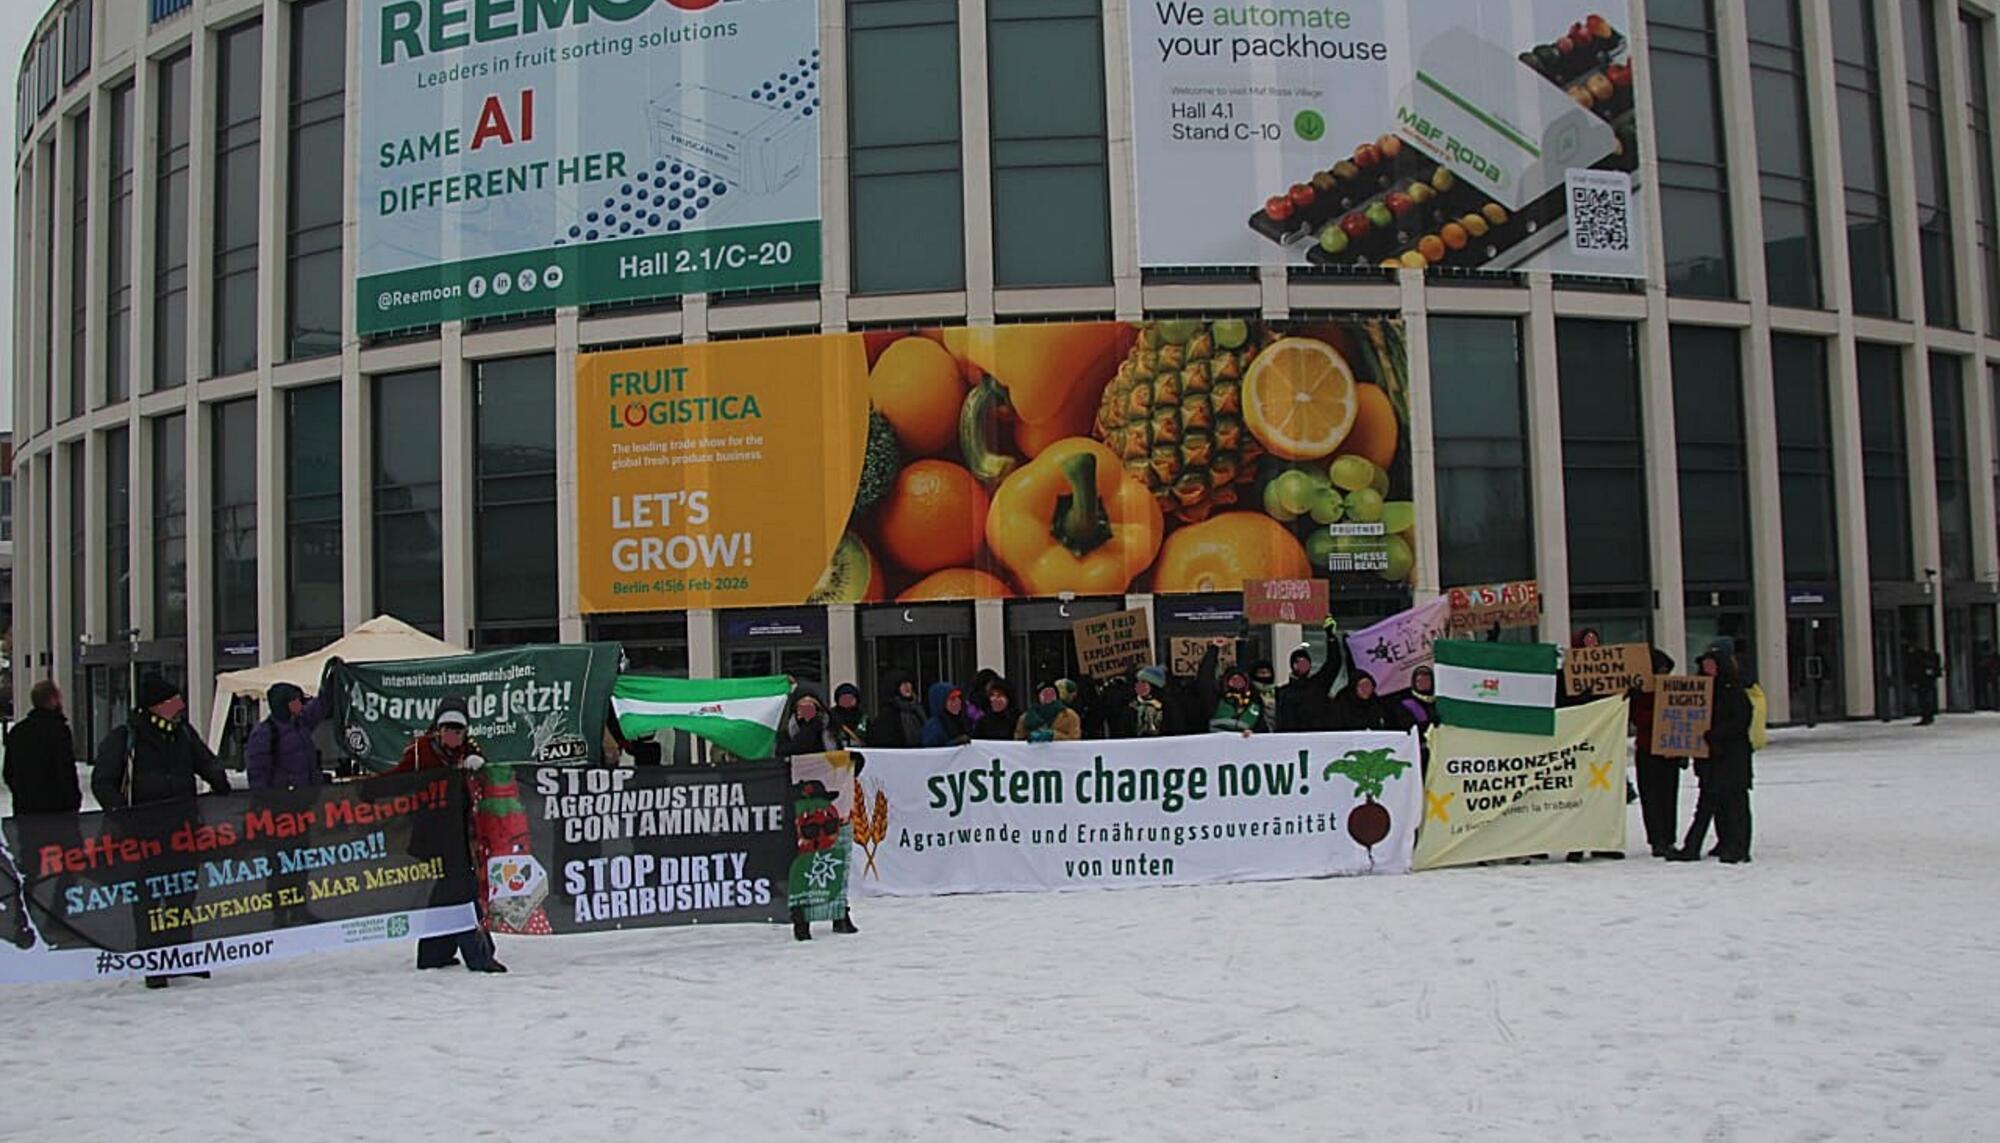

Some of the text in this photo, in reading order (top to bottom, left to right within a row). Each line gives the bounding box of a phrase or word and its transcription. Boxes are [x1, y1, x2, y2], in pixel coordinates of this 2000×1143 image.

[1156, 1, 1351, 29] We automate
[417, 20, 739, 88] Leaders in fruit sorting solutions
[1158, 33, 1388, 63] your packhouse
[1171, 102, 1234, 119] Hall 4.1
[380, 90, 534, 168] SAME AI
[1172, 123, 1281, 140] Stand C-10
[380, 161, 549, 216] DIFFERENT
[619, 240, 793, 279] Hall 2.1/C-20
[378, 282, 462, 311] @Reemoon
[609, 367, 689, 398] FRUIT
[612, 434, 763, 454] The leading trade show for the
[612, 457, 642, 470] global
[644, 455, 670, 466] fresh
[672, 453, 713, 466] produce
[612, 490, 710, 529] LET'S
[1332, 525, 1382, 534] FRUITNET
[612, 532, 753, 572] GROW!
[1354, 552, 1388, 561] MESSE
[1354, 560, 1388, 570] BERLIN
[613, 579, 650, 594] Berlin
[688, 579, 711, 592] Feb
[715, 577, 749, 590] 2026
[1571, 648, 1624, 662] FIGHT
[1571, 662, 1625, 675] UNION
[382, 665, 536, 687] International zusammenhalten:
[1572, 675, 1644, 693] BUSTING
[1664, 680, 1706, 692] HUMAN
[498, 681, 572, 722] jetzt!
[1668, 694, 1706, 706] RIGHTS
[539, 747, 571, 761] FAU
[537, 768, 635, 795] STOP
[927, 749, 1311, 817] system change now!
[1463, 774, 1529, 794] MACHT
[544, 782, 746, 820] AGROINDUSTRIA
[1467, 795, 1507, 813] VOM
[39, 780, 449, 877] Retten das Mar Menor!!
[564, 804, 784, 844] CONTAMINANTE
[900, 811, 1338, 852] Agrarwende und Ernährungssouveränität
[564, 852, 749, 895] STOP DIRTY
[1065, 854, 1175, 878] von unten
[574, 878, 771, 924] AGRIBUSINESS
[97, 938, 275, 975] #SOSMarMenor
